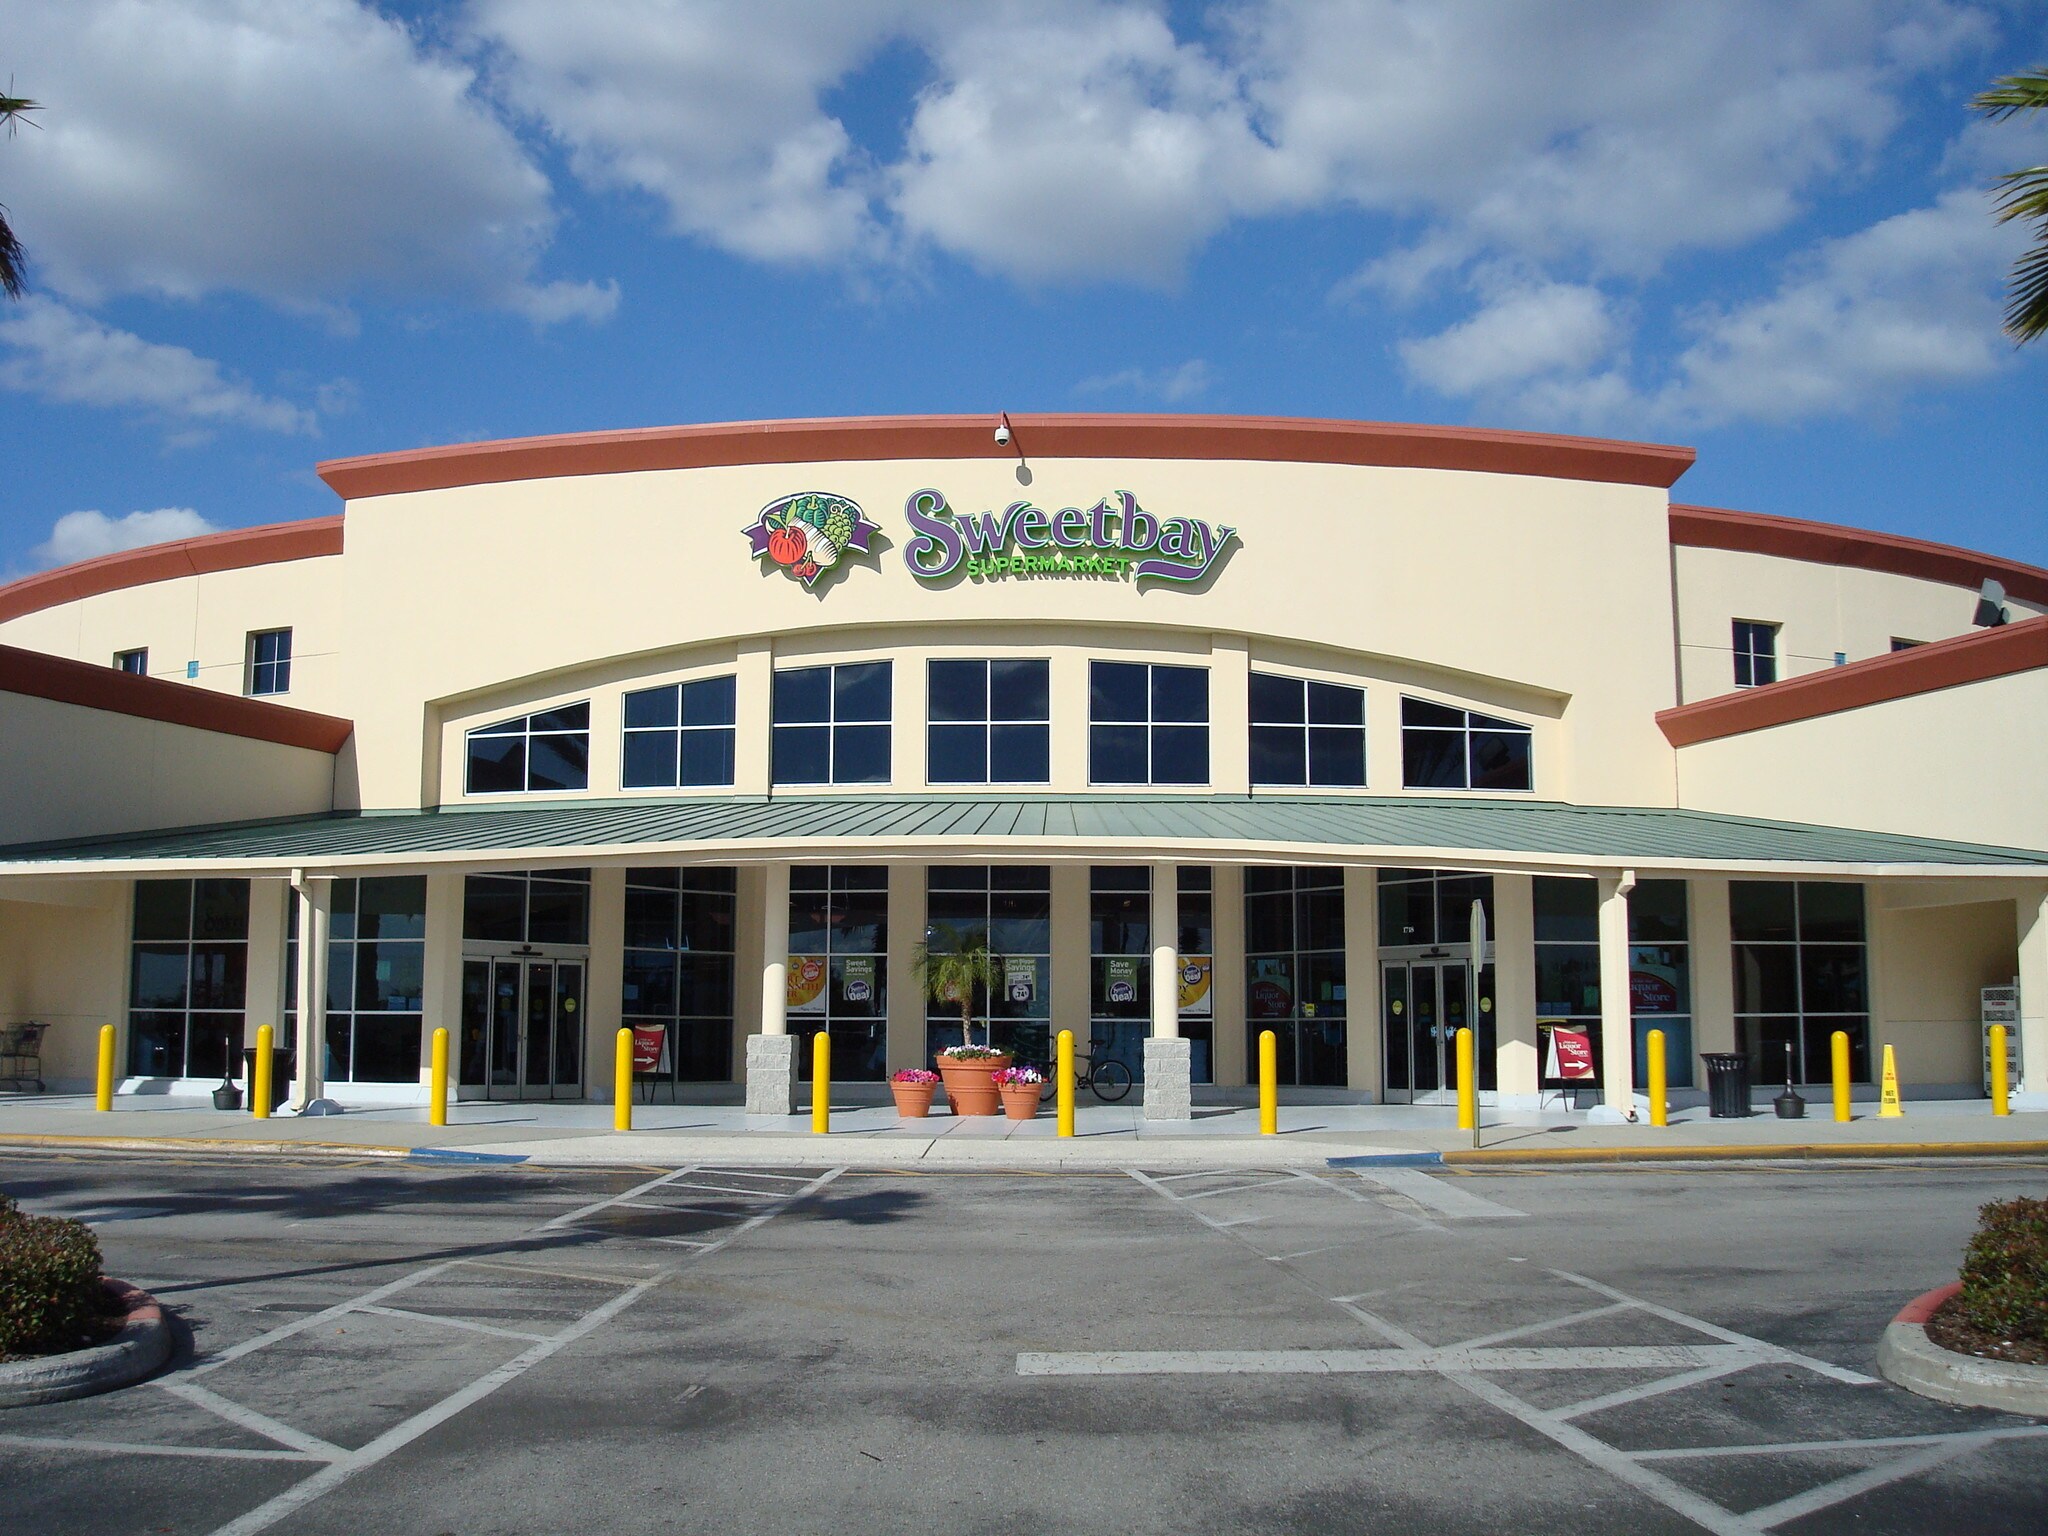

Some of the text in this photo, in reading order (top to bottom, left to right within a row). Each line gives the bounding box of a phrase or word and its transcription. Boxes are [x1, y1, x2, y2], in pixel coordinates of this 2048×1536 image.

[903, 488, 1237, 582] Sweetbay
[966, 555, 1130, 576] SUPERMARKET
[846, 959, 866, 967] Sweet
[1006, 964, 1035, 972] Savings
[1110, 960, 1129, 968] Save
[846, 965, 872, 974] Savings
[1631, 984, 1659, 994] iquor
[850, 989, 869, 1000] Deal
[1112, 991, 1133, 1001] Deal
[1255, 990, 1279, 1002] Liquor
[1643, 992, 1670, 1002] Store
